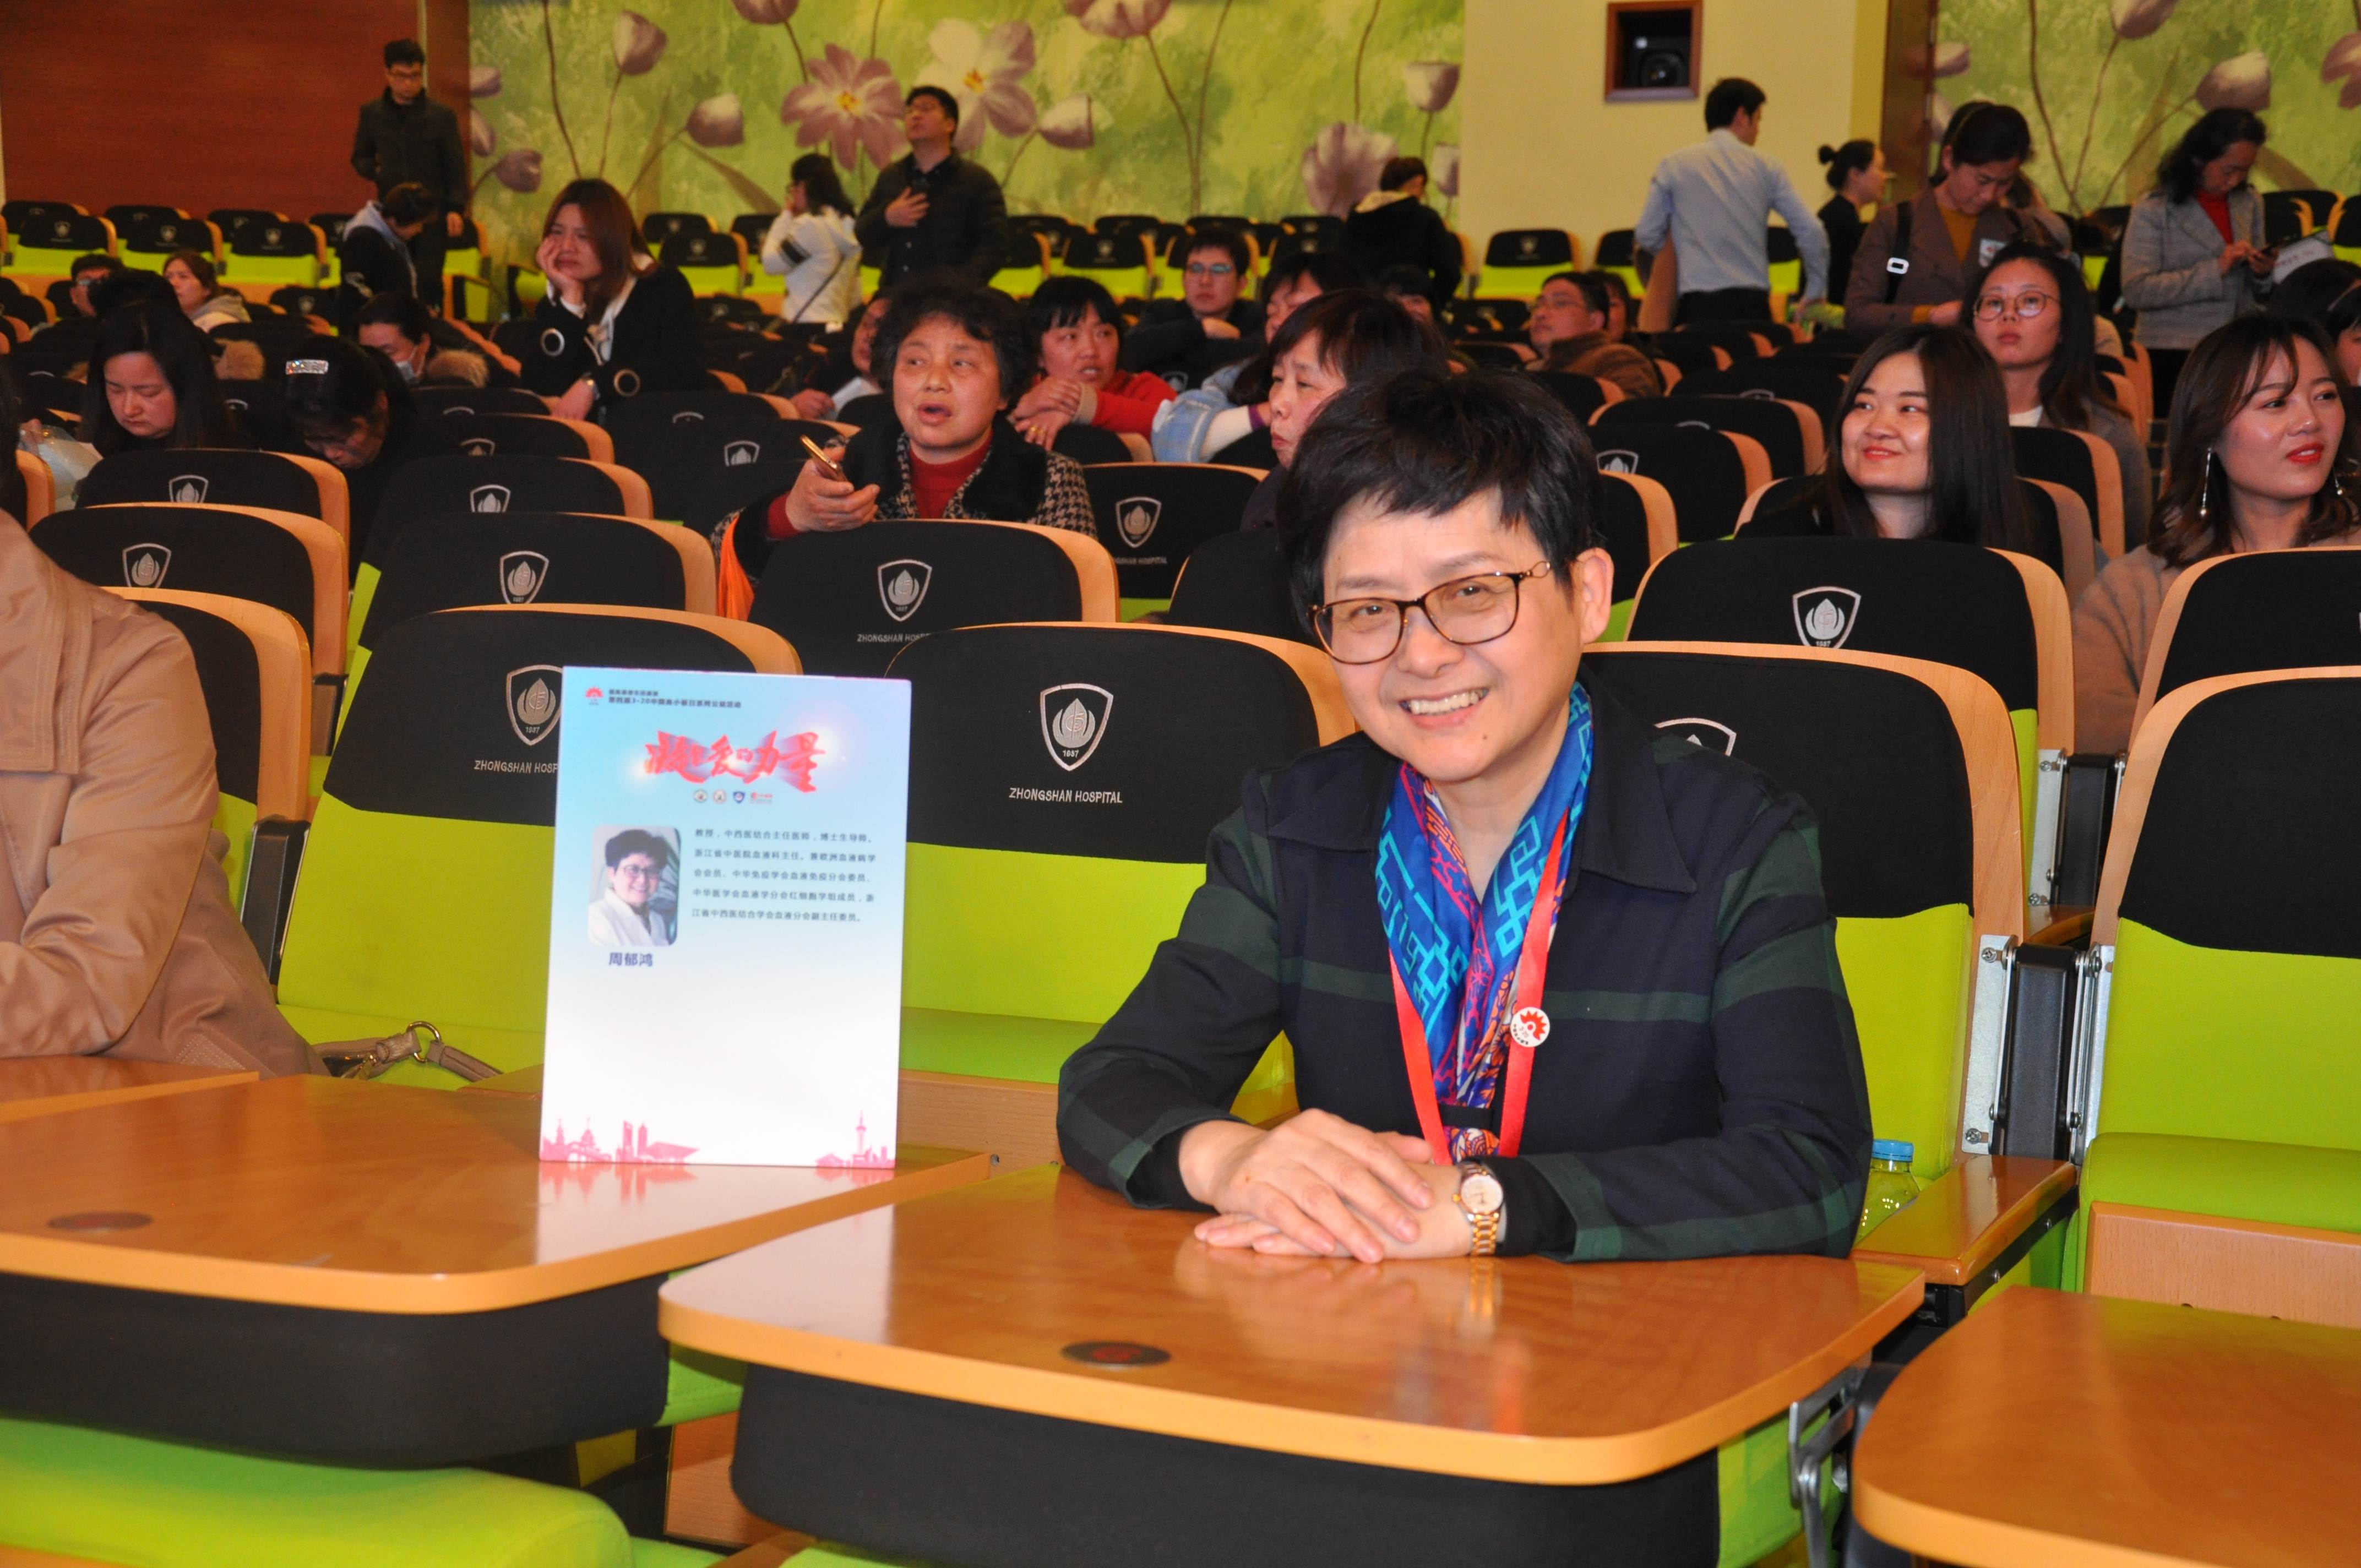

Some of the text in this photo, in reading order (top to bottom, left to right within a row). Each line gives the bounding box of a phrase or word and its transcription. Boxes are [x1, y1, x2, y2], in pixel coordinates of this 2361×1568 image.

[857, 634, 903, 643] ZHONGSHAN
[474, 760, 558, 774] ZHONGSHAN HOSP
[1009, 787, 1123, 803] ZHONGSHAN HOSPITAL
